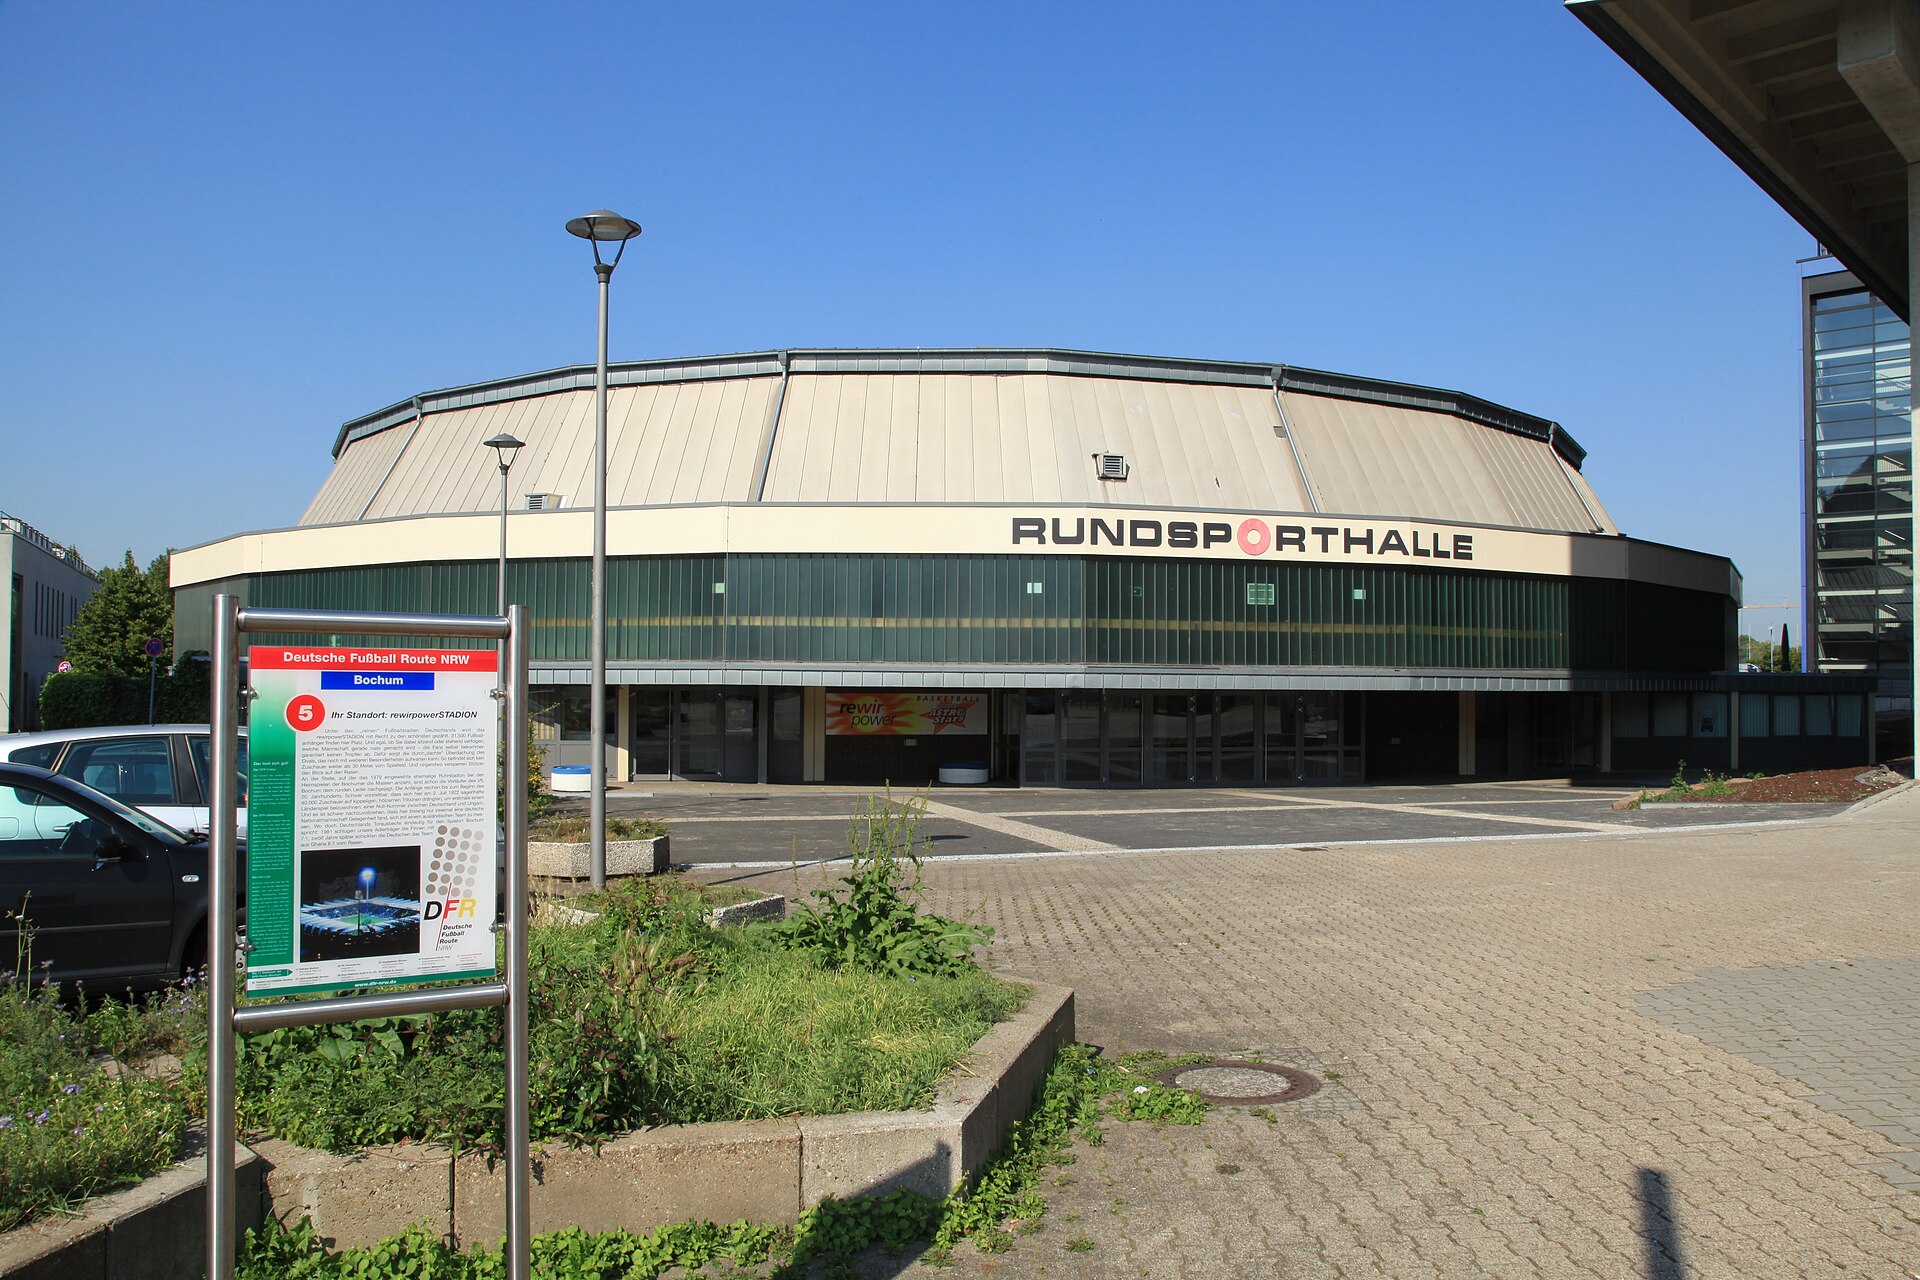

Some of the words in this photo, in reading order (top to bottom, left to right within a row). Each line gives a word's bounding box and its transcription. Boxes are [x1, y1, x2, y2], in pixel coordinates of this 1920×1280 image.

[1012, 517, 1474, 561] RUNDSPORTHALLE
[283, 652, 346, 663] Deutsche
[350, 653, 396, 664] Fußball
[400, 654, 437, 664] Route
[440, 655, 470, 665] NRW
[354, 675, 404, 685] Bochum
[298, 705, 313, 722] 5
[840, 700, 884, 714] rewir
[346, 711, 388, 719] Standort:
[390, 711, 478, 720] rewirpowerSTADION
[850, 715, 896, 728] power
[424, 898, 476, 920] DFR
